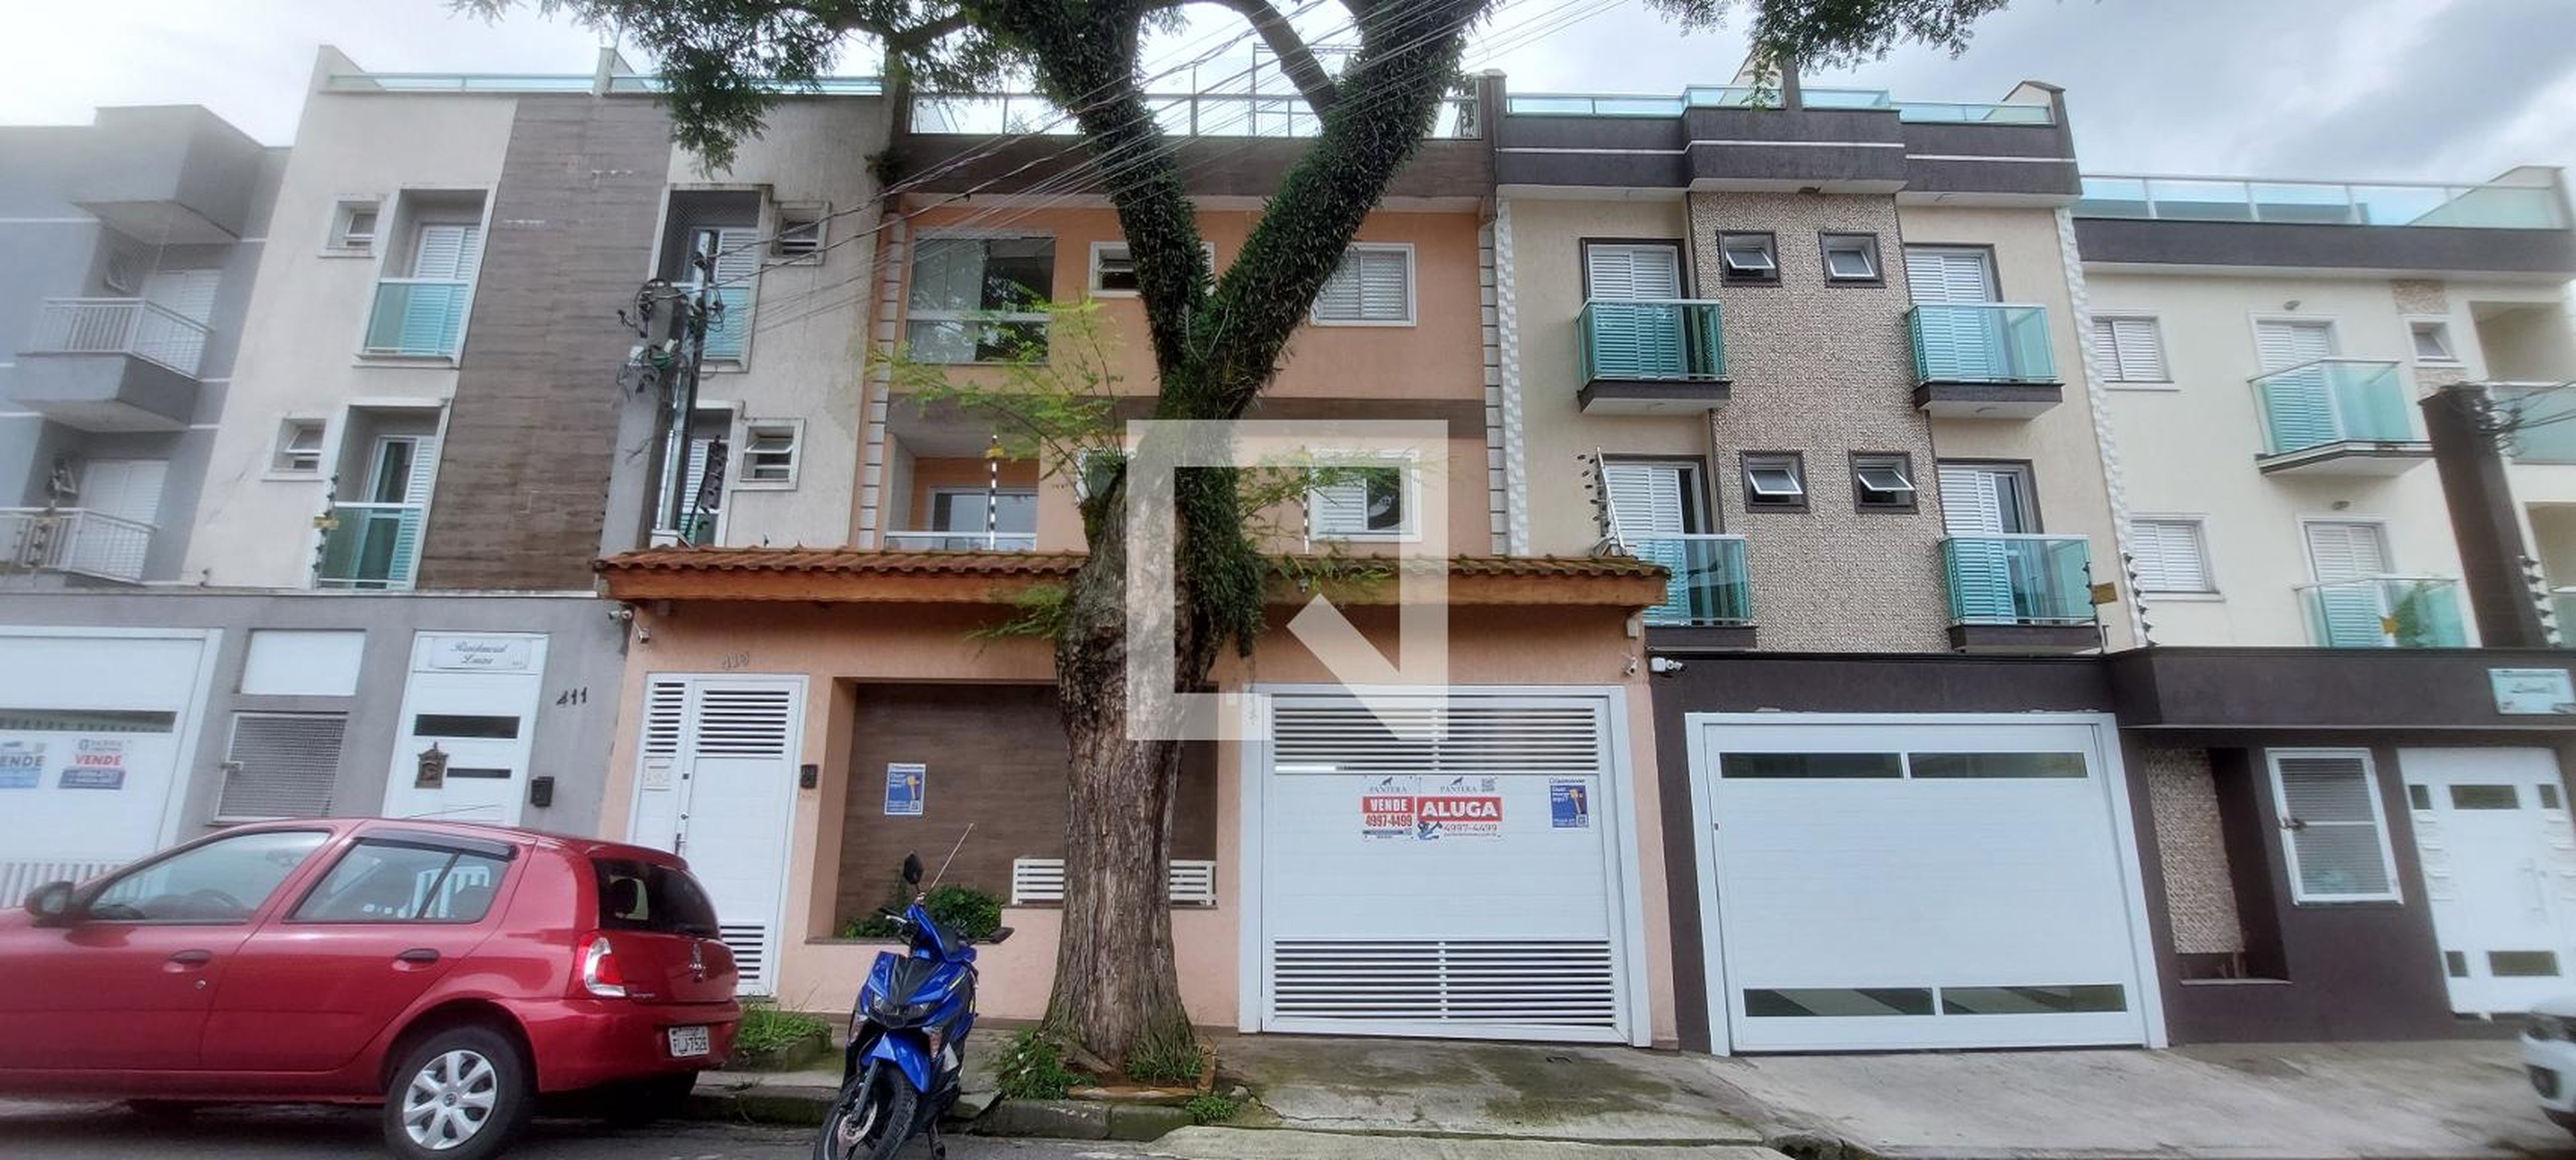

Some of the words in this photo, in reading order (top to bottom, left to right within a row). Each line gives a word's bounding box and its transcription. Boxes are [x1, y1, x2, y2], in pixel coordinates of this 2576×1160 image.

[555, 686, 588, 705] 411
[74, 755, 122, 766] VENDE
[1370, 798, 1408, 812] VENDE
[1421, 801, 1498, 817] ALUGA
[1366, 814, 1412, 827] 4997-4499
